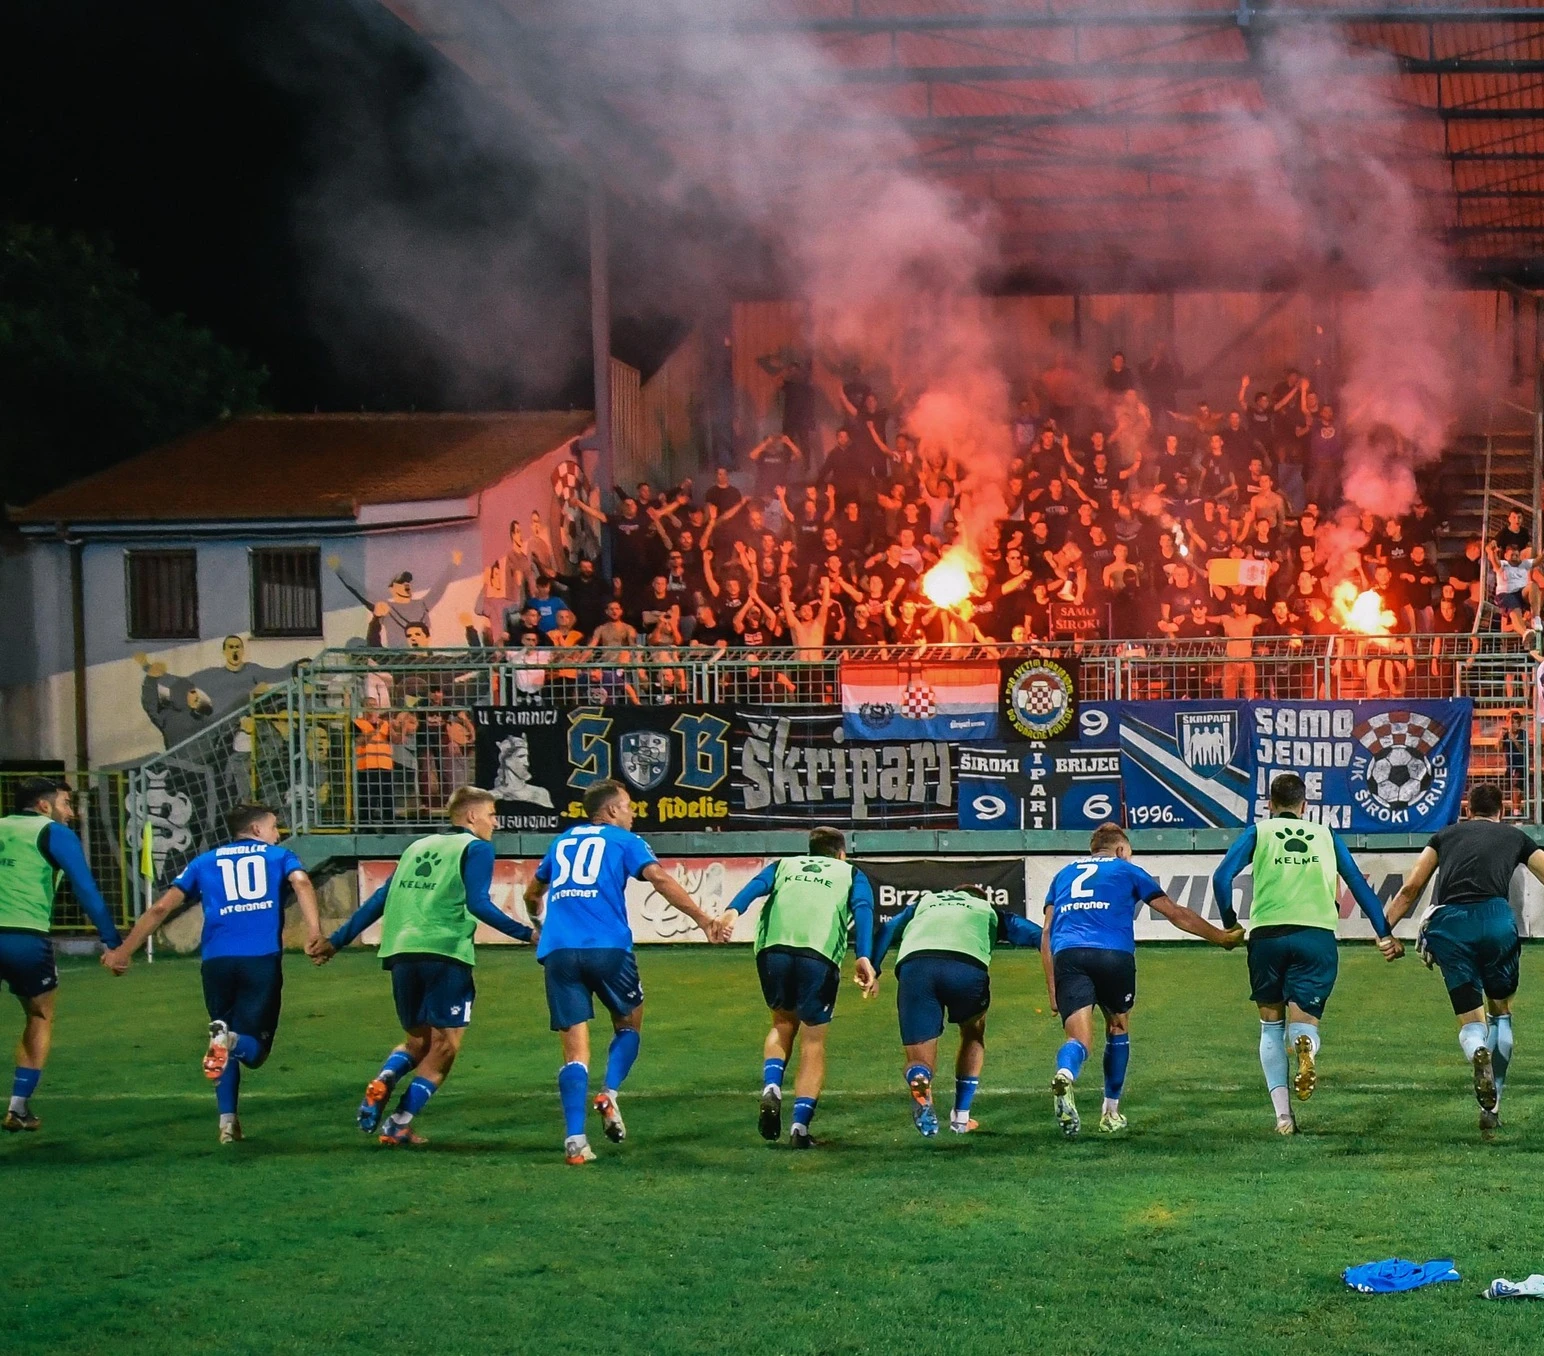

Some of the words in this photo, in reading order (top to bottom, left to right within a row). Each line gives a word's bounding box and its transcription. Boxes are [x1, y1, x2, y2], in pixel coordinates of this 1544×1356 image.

[1060, 607, 1096, 616] SAMO
[1079, 709, 1109, 737] 9
[1182, 714, 1231, 724] ŠKRIPARI
[1254, 707, 1354, 738] SAMO
[670, 713, 729, 792] B
[960, 754, 1020, 774] ŠIROKI
[1055, 757, 1120, 774] BRIJEG
[1256, 738, 1353, 768] JEDNO
[1351, 756, 1367, 781] NK
[1256, 767, 1323, 800] IE
[1416, 754, 1448, 816] BRIJEG
[657, 796, 729, 823] fidelis
[972, 795, 1007, 820] 9
[1082, 794, 1112, 820] 6
[1130, 805, 1184, 825] 1996...
[1254, 797, 1352, 829] ŠOKI
[1354, 789, 1409, 824] ŠIROKI
[552, 836, 606, 888] 50
[1274, 855, 1320, 865] KELME
[216, 855, 268, 901] 10
[785, 875, 834, 889] KELME
[1070, 863, 1099, 899] 2
